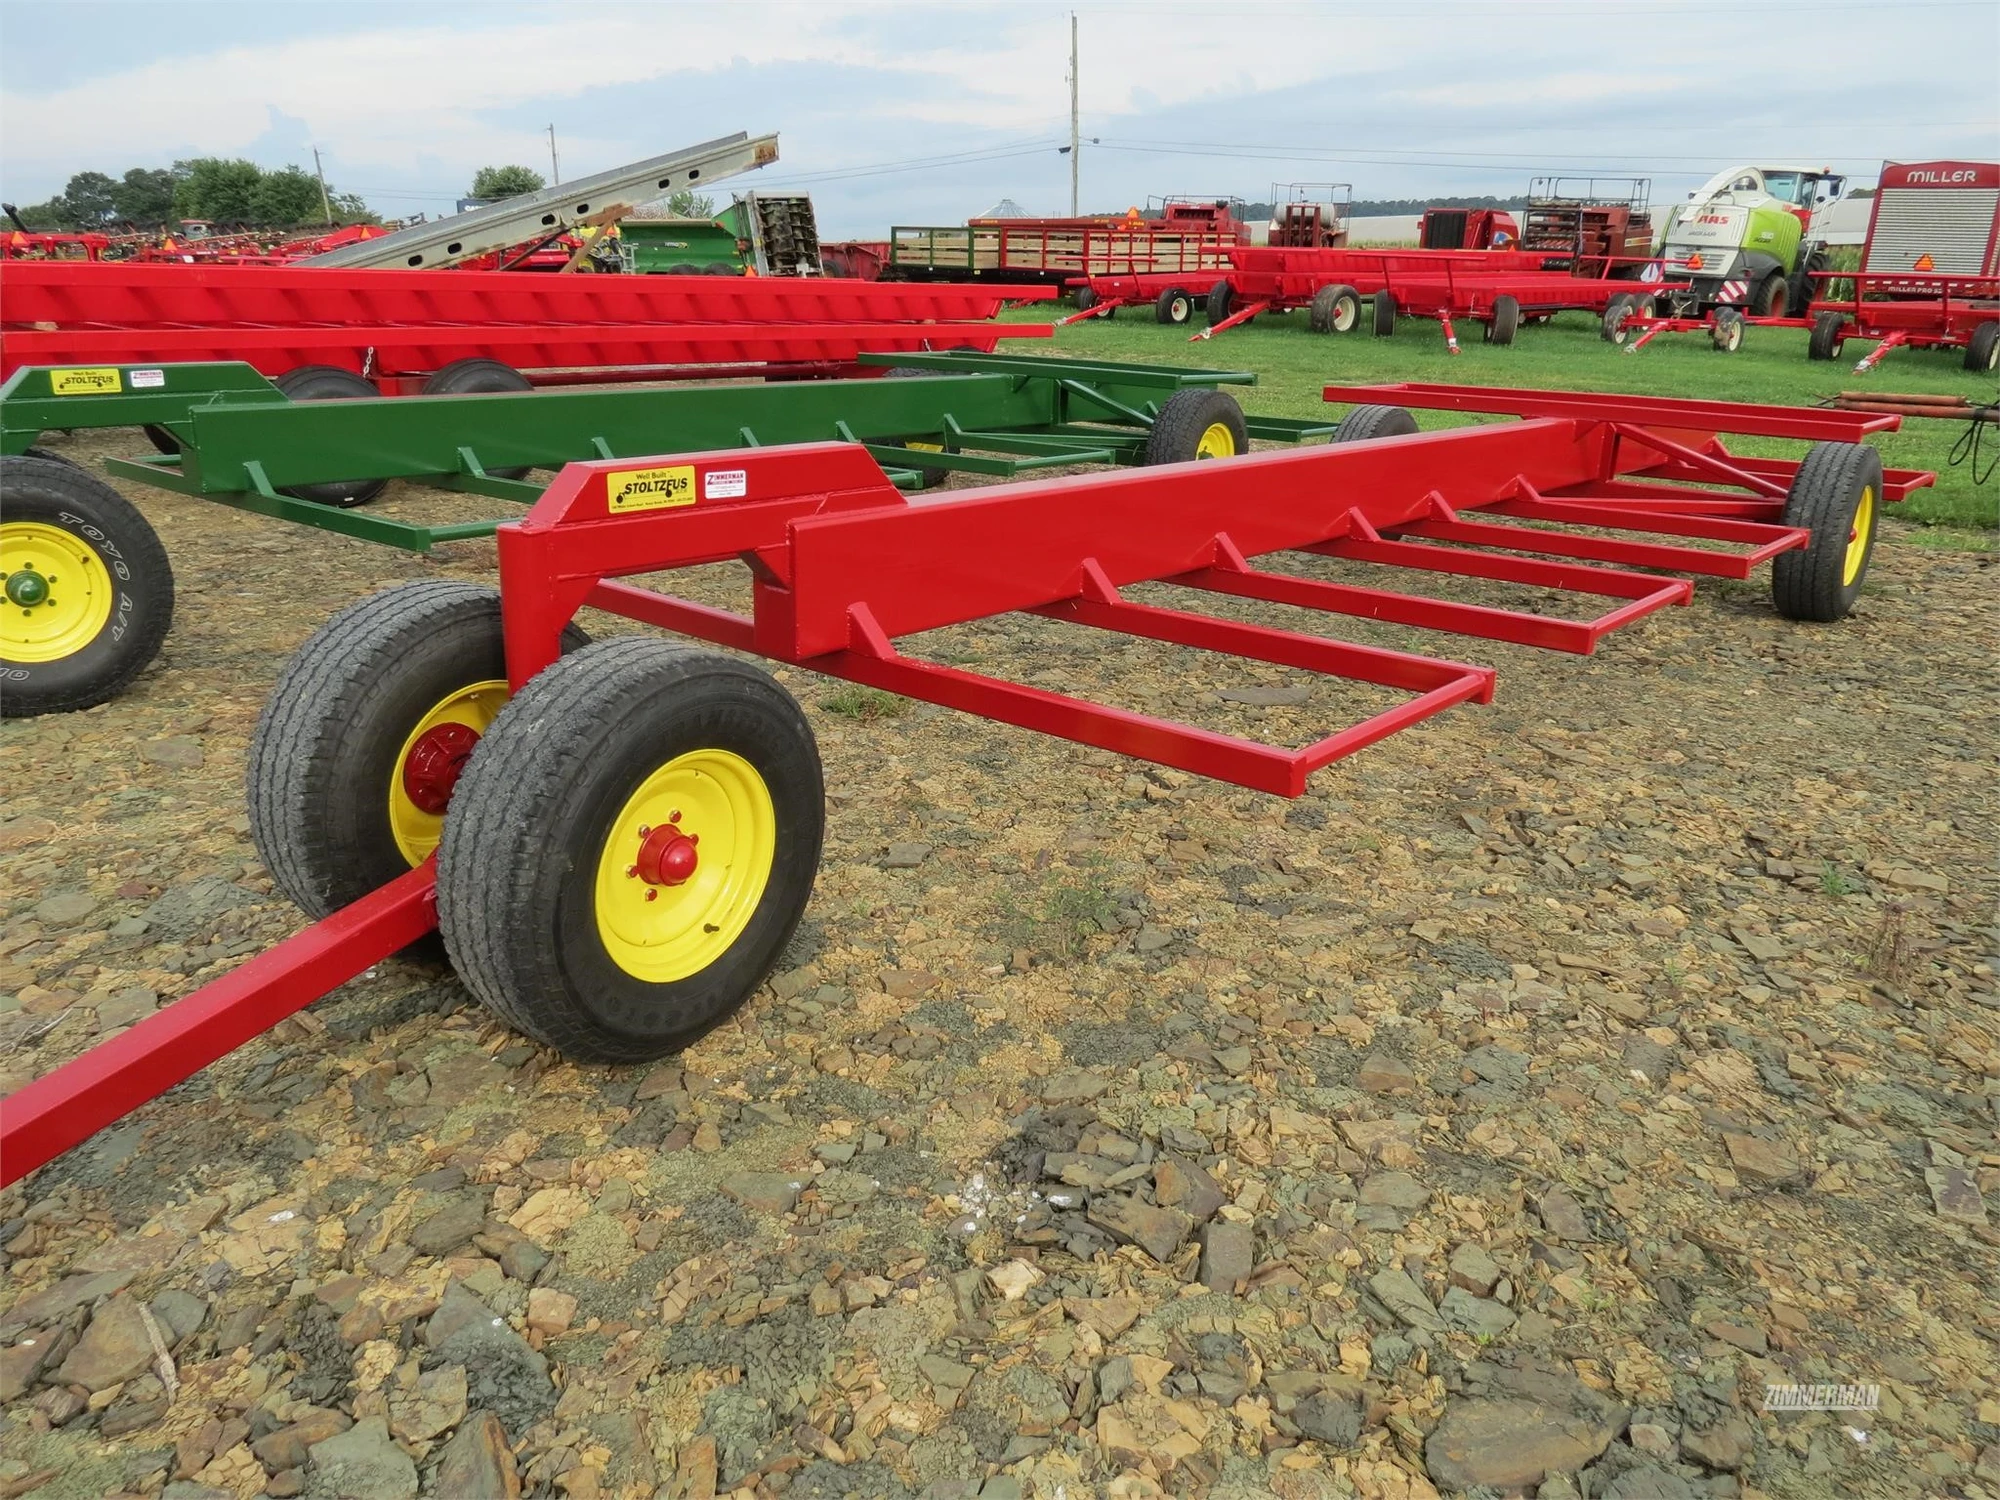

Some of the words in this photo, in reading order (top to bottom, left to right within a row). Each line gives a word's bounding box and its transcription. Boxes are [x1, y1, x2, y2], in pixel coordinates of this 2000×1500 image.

[1906, 170, 1976, 183] MILLER
[1697, 214, 1730, 225] AAS
[65, 375, 115, 384] STOLTZFUS
[651, 471, 667, 479] Built
[624, 477, 688, 495] STOLTZFUS
[58, 511, 131, 581] TOYO
[111, 592, 133, 642] A/T
